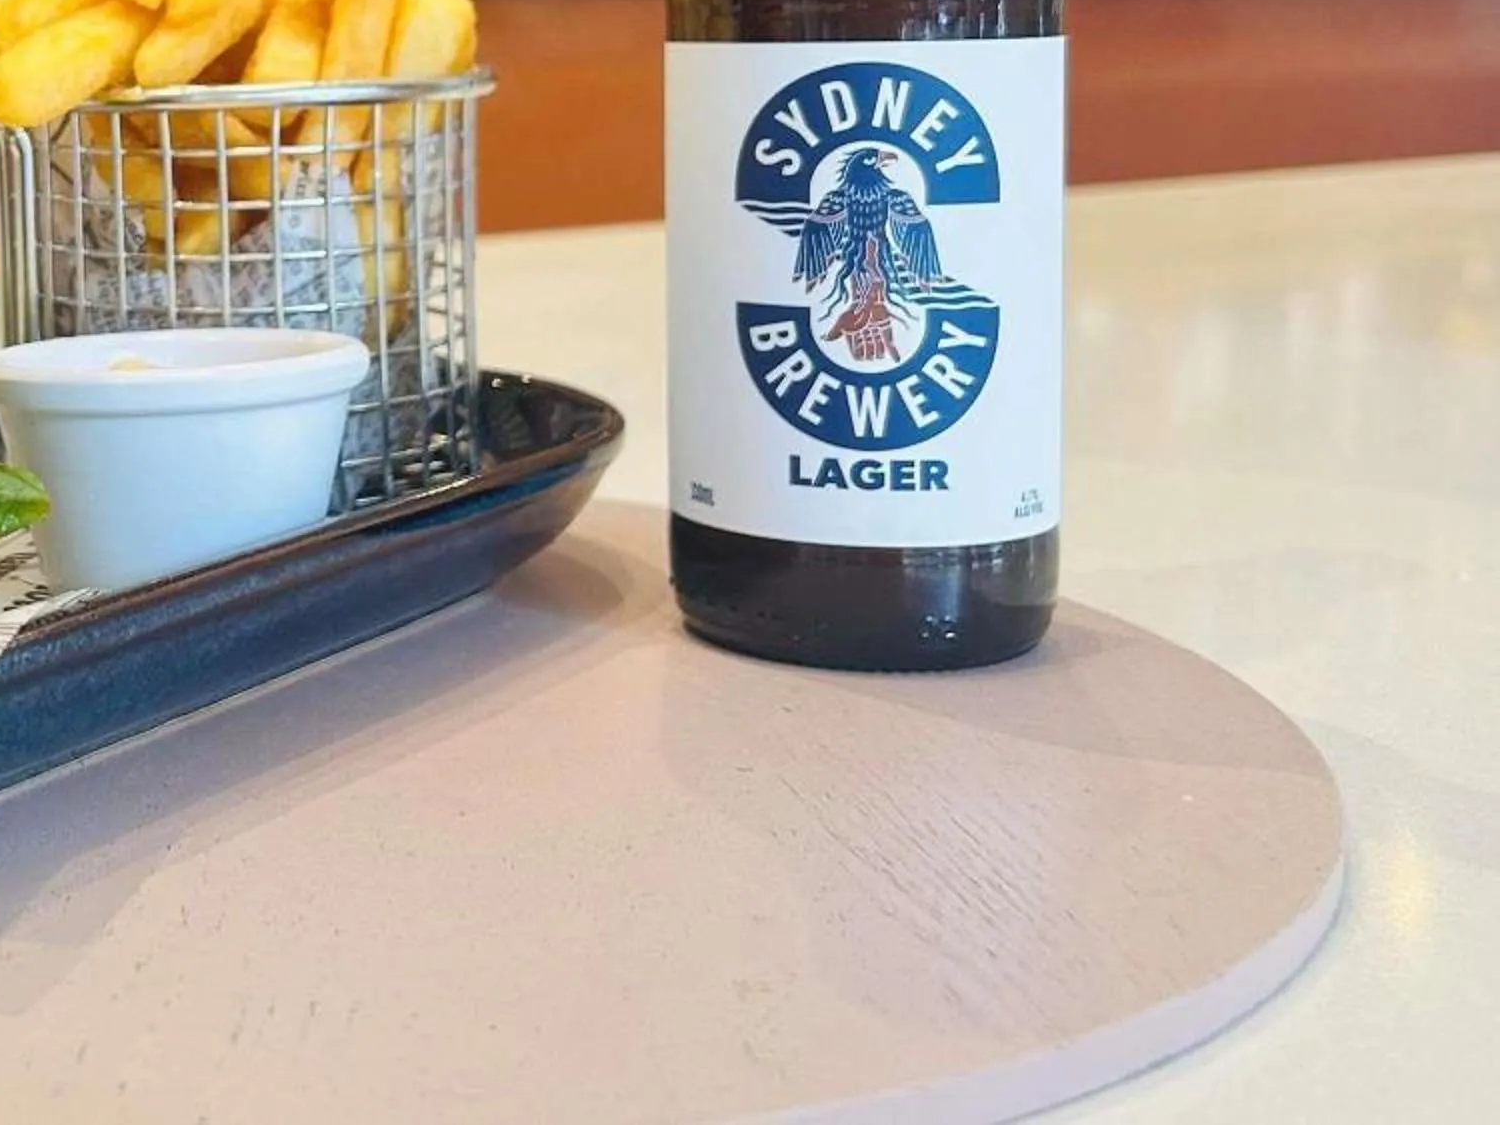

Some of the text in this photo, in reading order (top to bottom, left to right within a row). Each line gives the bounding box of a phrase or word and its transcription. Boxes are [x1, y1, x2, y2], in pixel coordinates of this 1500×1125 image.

[755, 77, 985, 177] SYDNEY
[750, 319, 988, 438] BREWERY
[788, 455, 950, 492] LAGER
